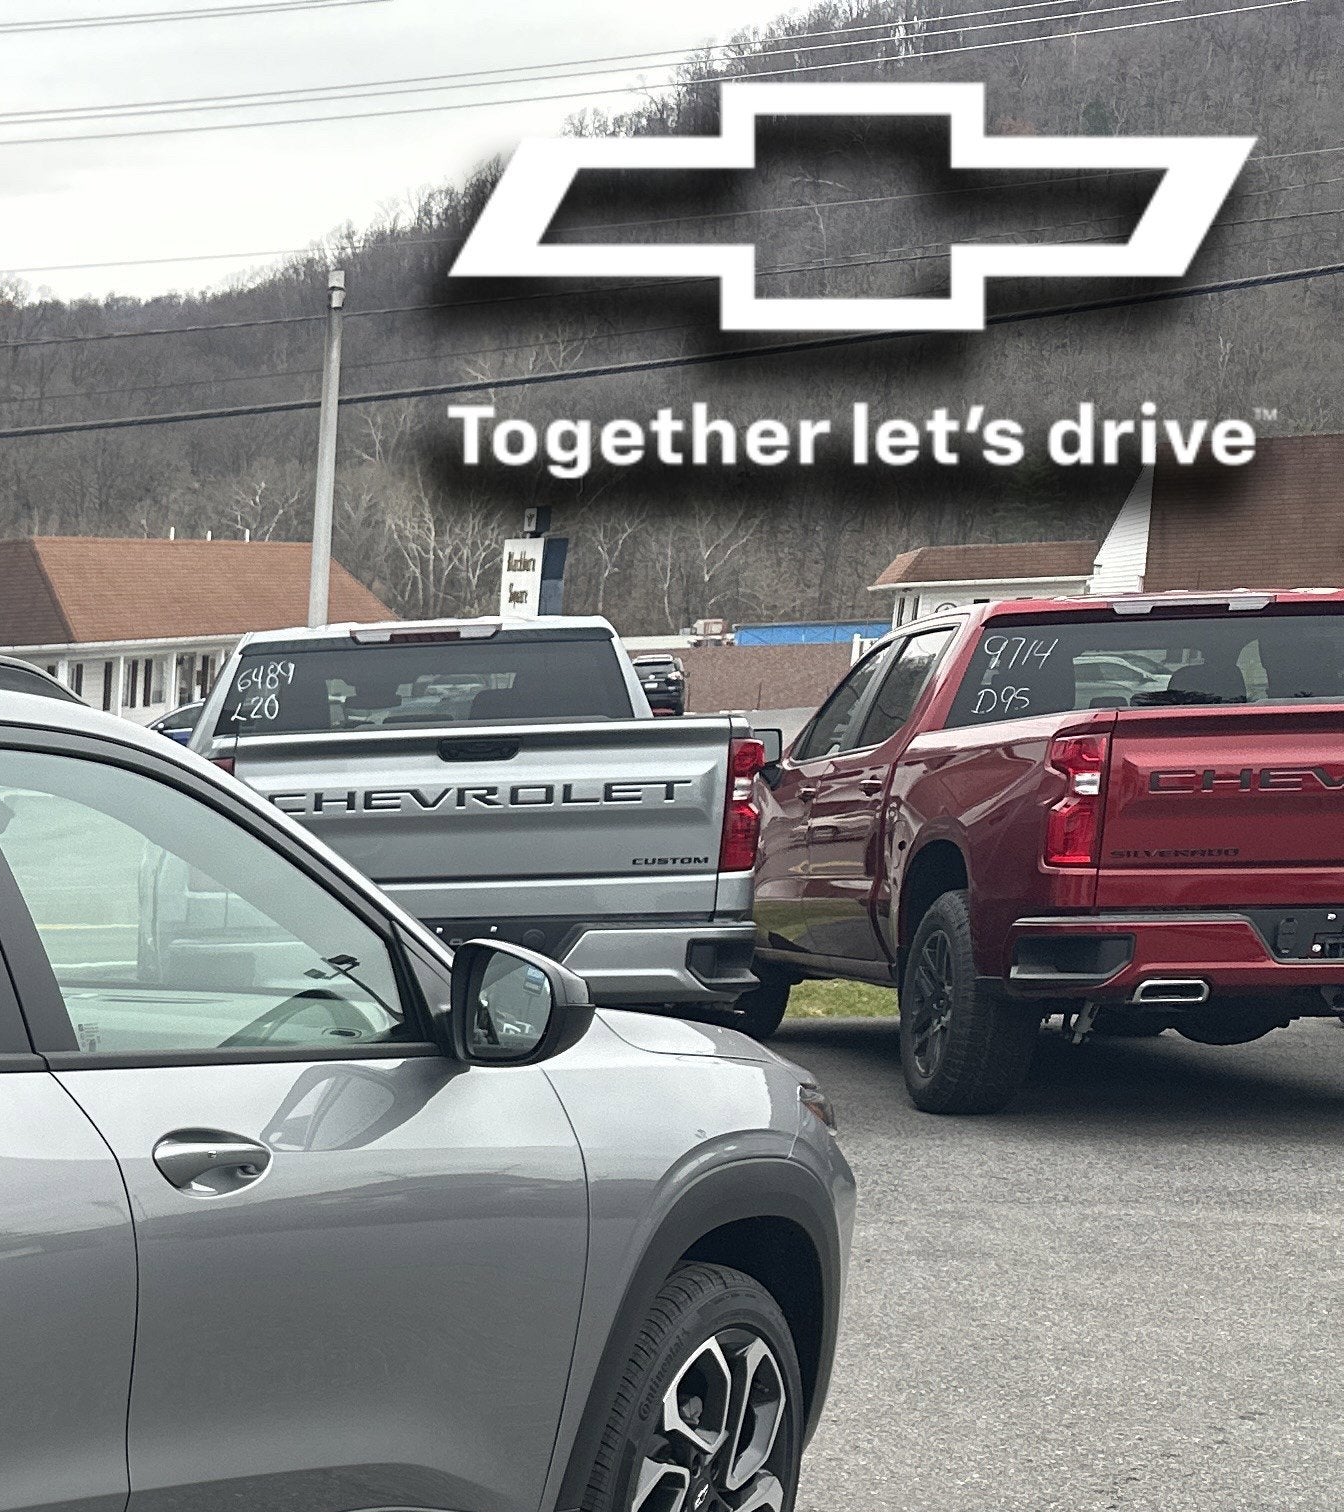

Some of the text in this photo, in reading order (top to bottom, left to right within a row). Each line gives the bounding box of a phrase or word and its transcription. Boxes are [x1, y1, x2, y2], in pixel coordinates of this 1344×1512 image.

[984, 635, 1059, 670] 9714
[237, 659, 296, 693] 6489
[970, 685, 1031, 714] D95
[269, 779, 694, 815] CHEVROLET
[631, 856, 710, 867] CUSTOM
